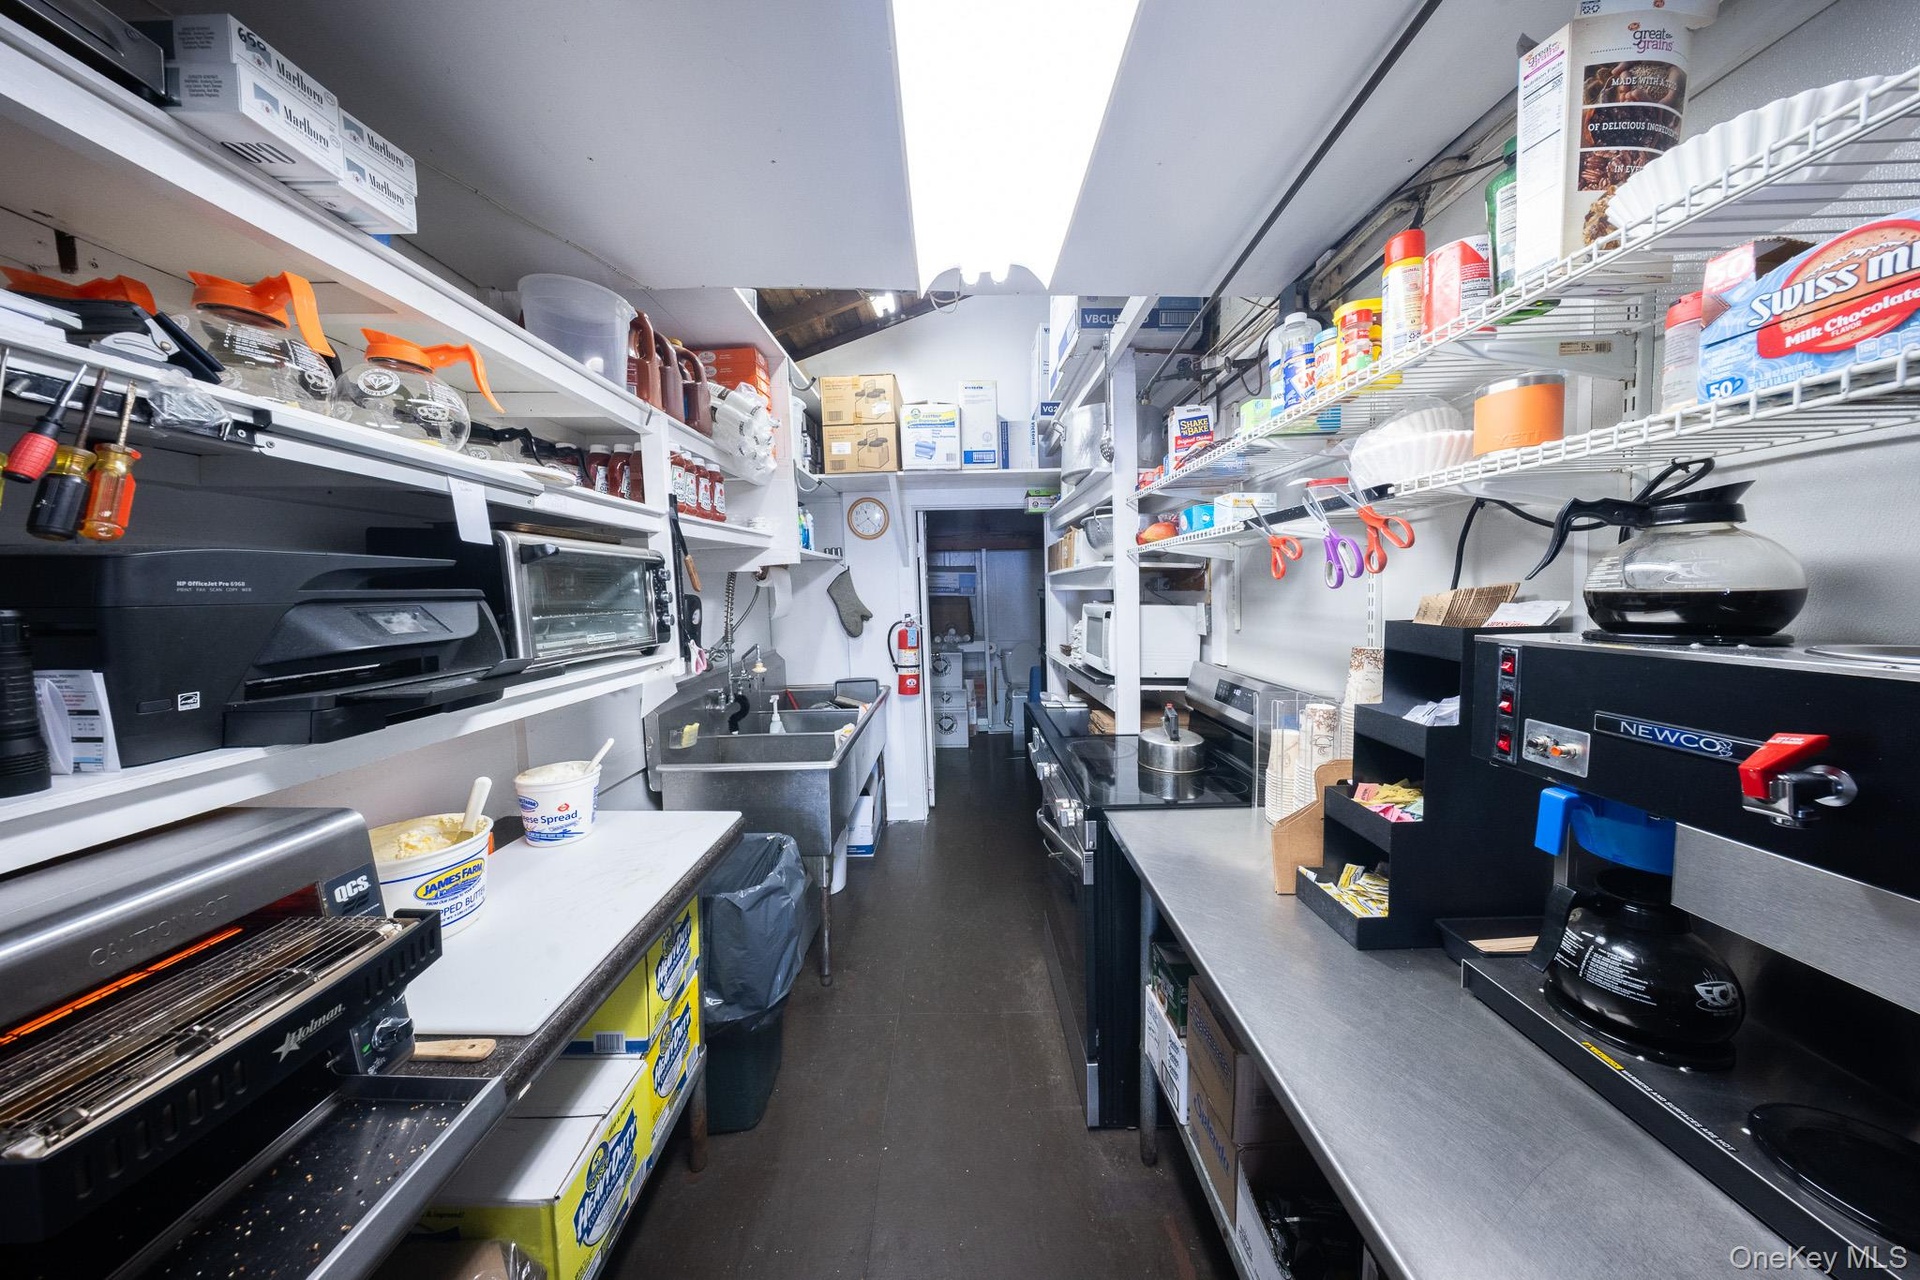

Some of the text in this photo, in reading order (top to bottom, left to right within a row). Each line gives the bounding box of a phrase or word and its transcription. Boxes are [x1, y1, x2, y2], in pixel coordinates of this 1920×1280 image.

[1633, 28, 1666, 46] great
[1636, 39, 1673, 54] grains
[276, 58, 324, 105] Marlboro
[1611, 76, 1637, 87] MADE
[1637, 77, 1659, 86] WITH
[284, 105, 329, 148] Marlboro
[1588, 123, 1600, 132] OF
[1602, 121, 1646, 131] DELICIOUS
[367, 133, 404, 168] Marlboro
[1614, 165, 1625, 173] IN
[368, 173, 405, 206] Marlboro
[1867, 239, 1920, 283] MI
[1785, 325, 1824, 349] Milk
[1830, 319, 1863, 338] FLAVOR
[1709, 381, 1733, 400] 50
[1180, 418, 1209, 431] SHAKE
[1187, 425, 1209, 437] BAKE
[1620, 721, 1721, 752] NEWCO
[540, 809, 578, 825] Spread
[334, 875, 369, 903] QCS
[423, 862, 483, 897] JAMES FARM
[440, 901, 463, 918] PPED
[288, 1003, 342, 1044] Holman
[1651, 1090, 1667, 1103] AND
[1665, 1101, 1702, 1128] SURFACES
[1700, 1127, 1719, 1142] ARE
[1716, 1139, 1737, 1152] HOT
[577, 1160, 612, 1241] HEAVY
[611, 1113, 637, 1174] DUTY
